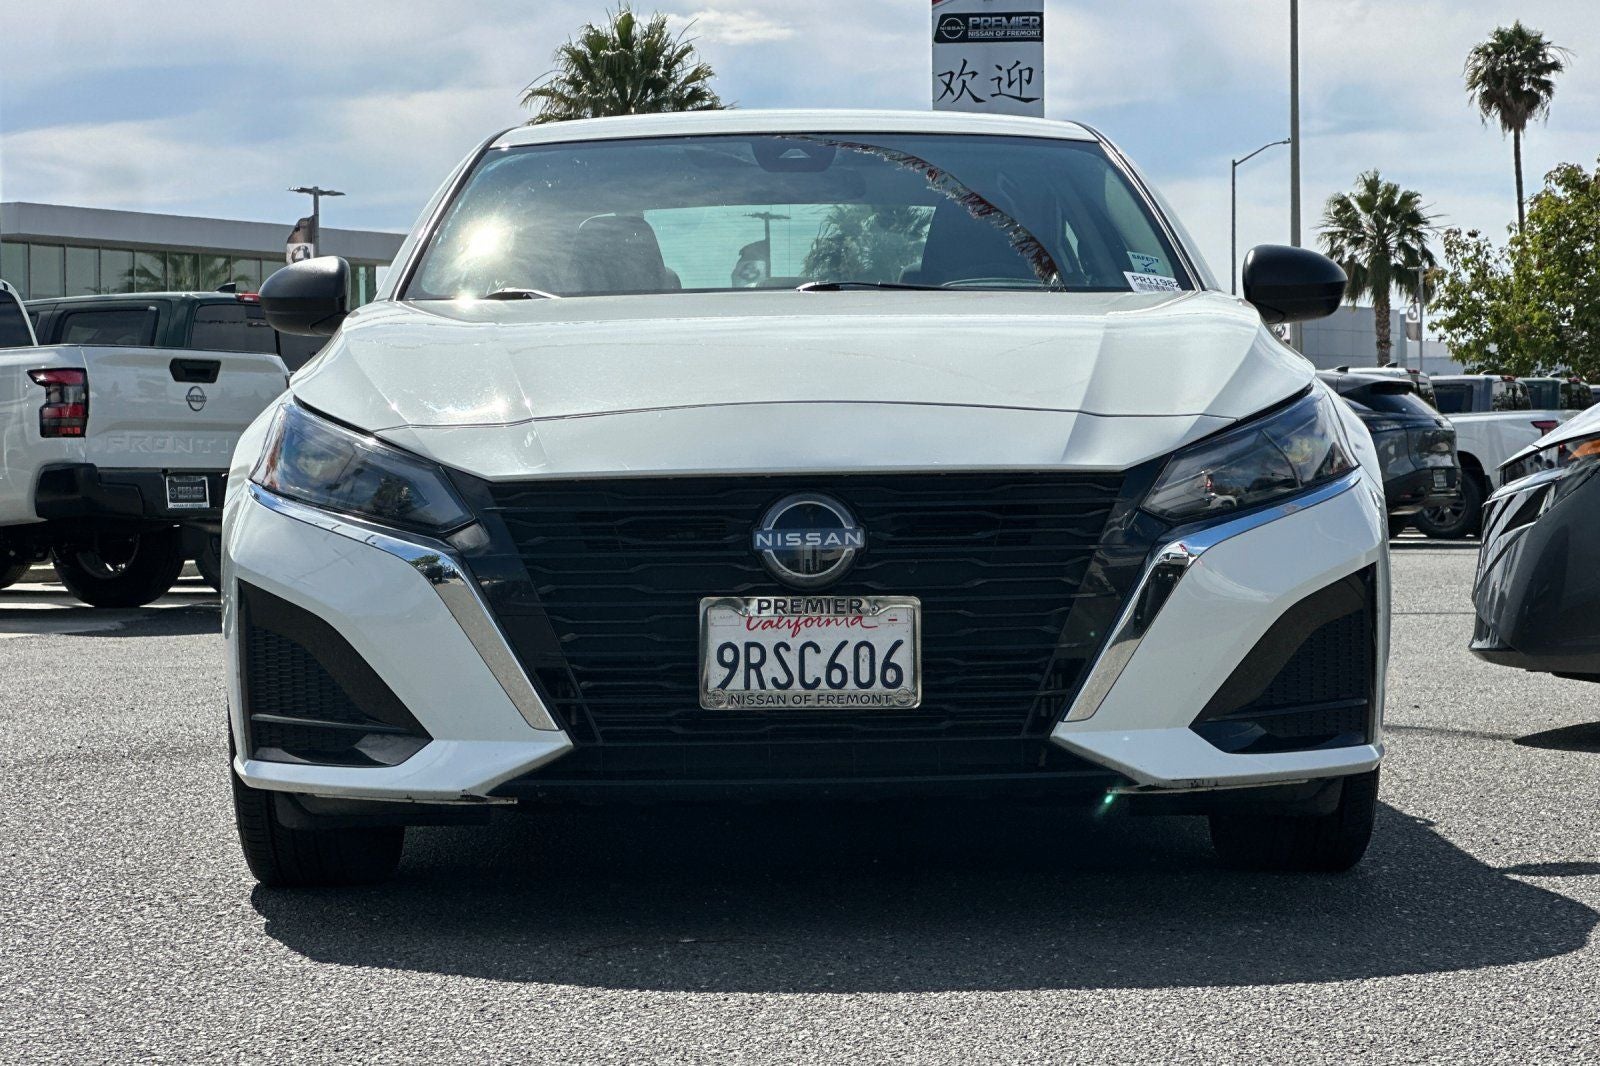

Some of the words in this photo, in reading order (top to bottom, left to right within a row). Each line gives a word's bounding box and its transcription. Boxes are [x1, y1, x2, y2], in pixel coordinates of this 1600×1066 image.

[968, 16, 1040, 30] PREMIER
[937, 58, 1041, 103] 欢迎
[756, 532, 862, 547] NISSAN
[757, 598, 863, 615] PREMIER
[746, 614, 878, 638] California
[716, 639, 904, 690] 9RSC606
[730, 694, 787, 705] NISSAN
[792, 694, 812, 705] OF
[817, 694, 890, 705] FREMONT
